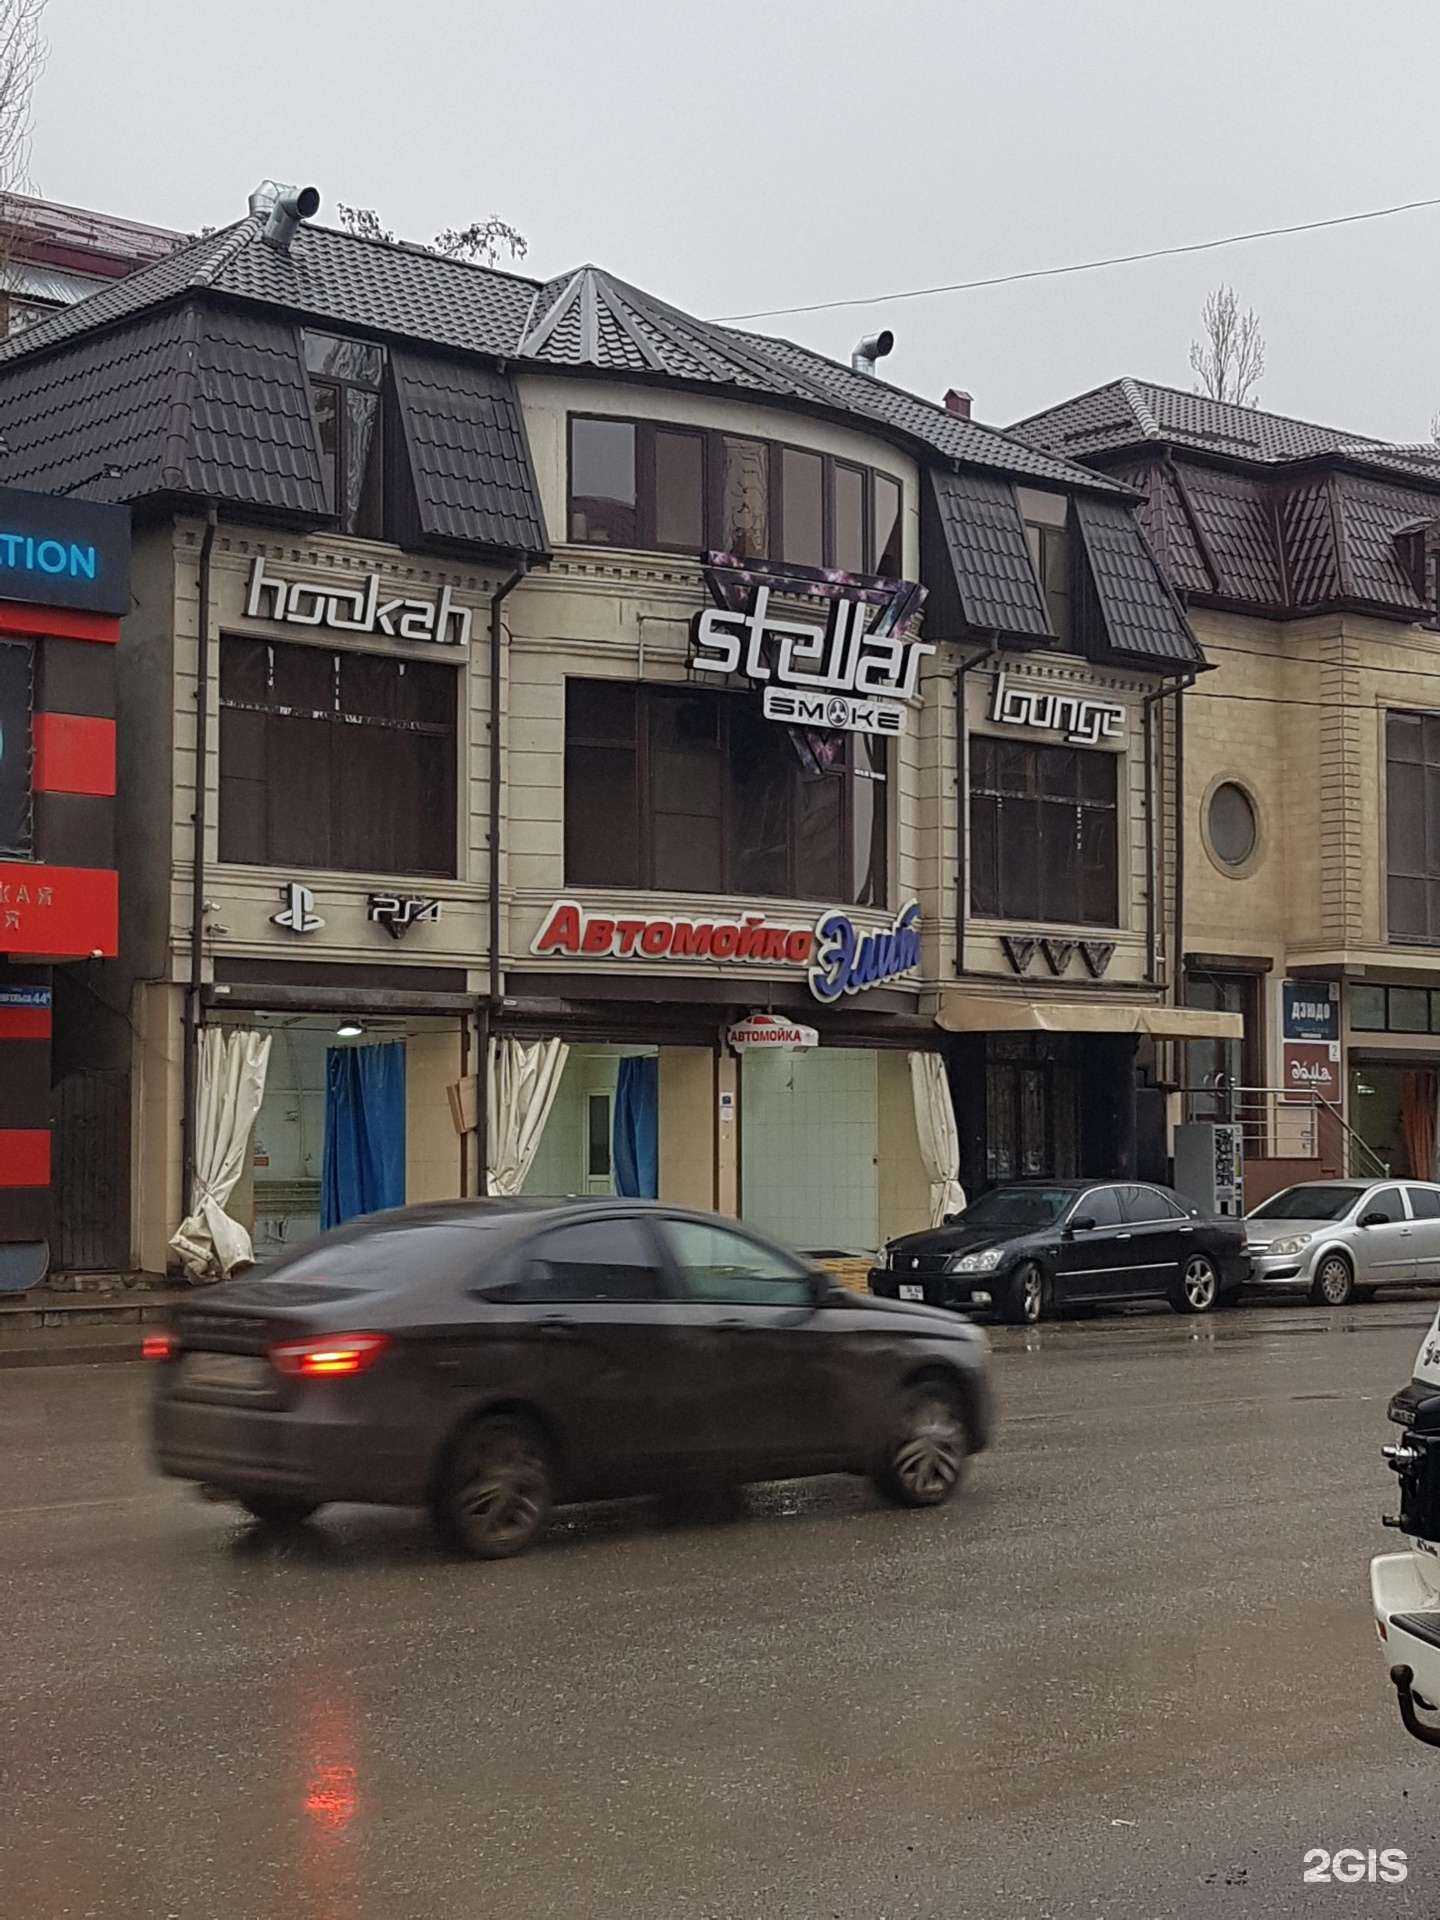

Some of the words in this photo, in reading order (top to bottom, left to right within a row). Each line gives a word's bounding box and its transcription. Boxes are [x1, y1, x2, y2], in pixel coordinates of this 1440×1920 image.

[0, 533, 96, 578] TION
[247, 556, 473, 645] hookah
[693, 585, 937, 699] stellar
[769, 696, 900, 731] SMOKE
[993, 671, 1127, 744] lounge
[372, 897, 442, 922] PS4
[731, 1027, 802, 1042] АВТОМОЙКА
